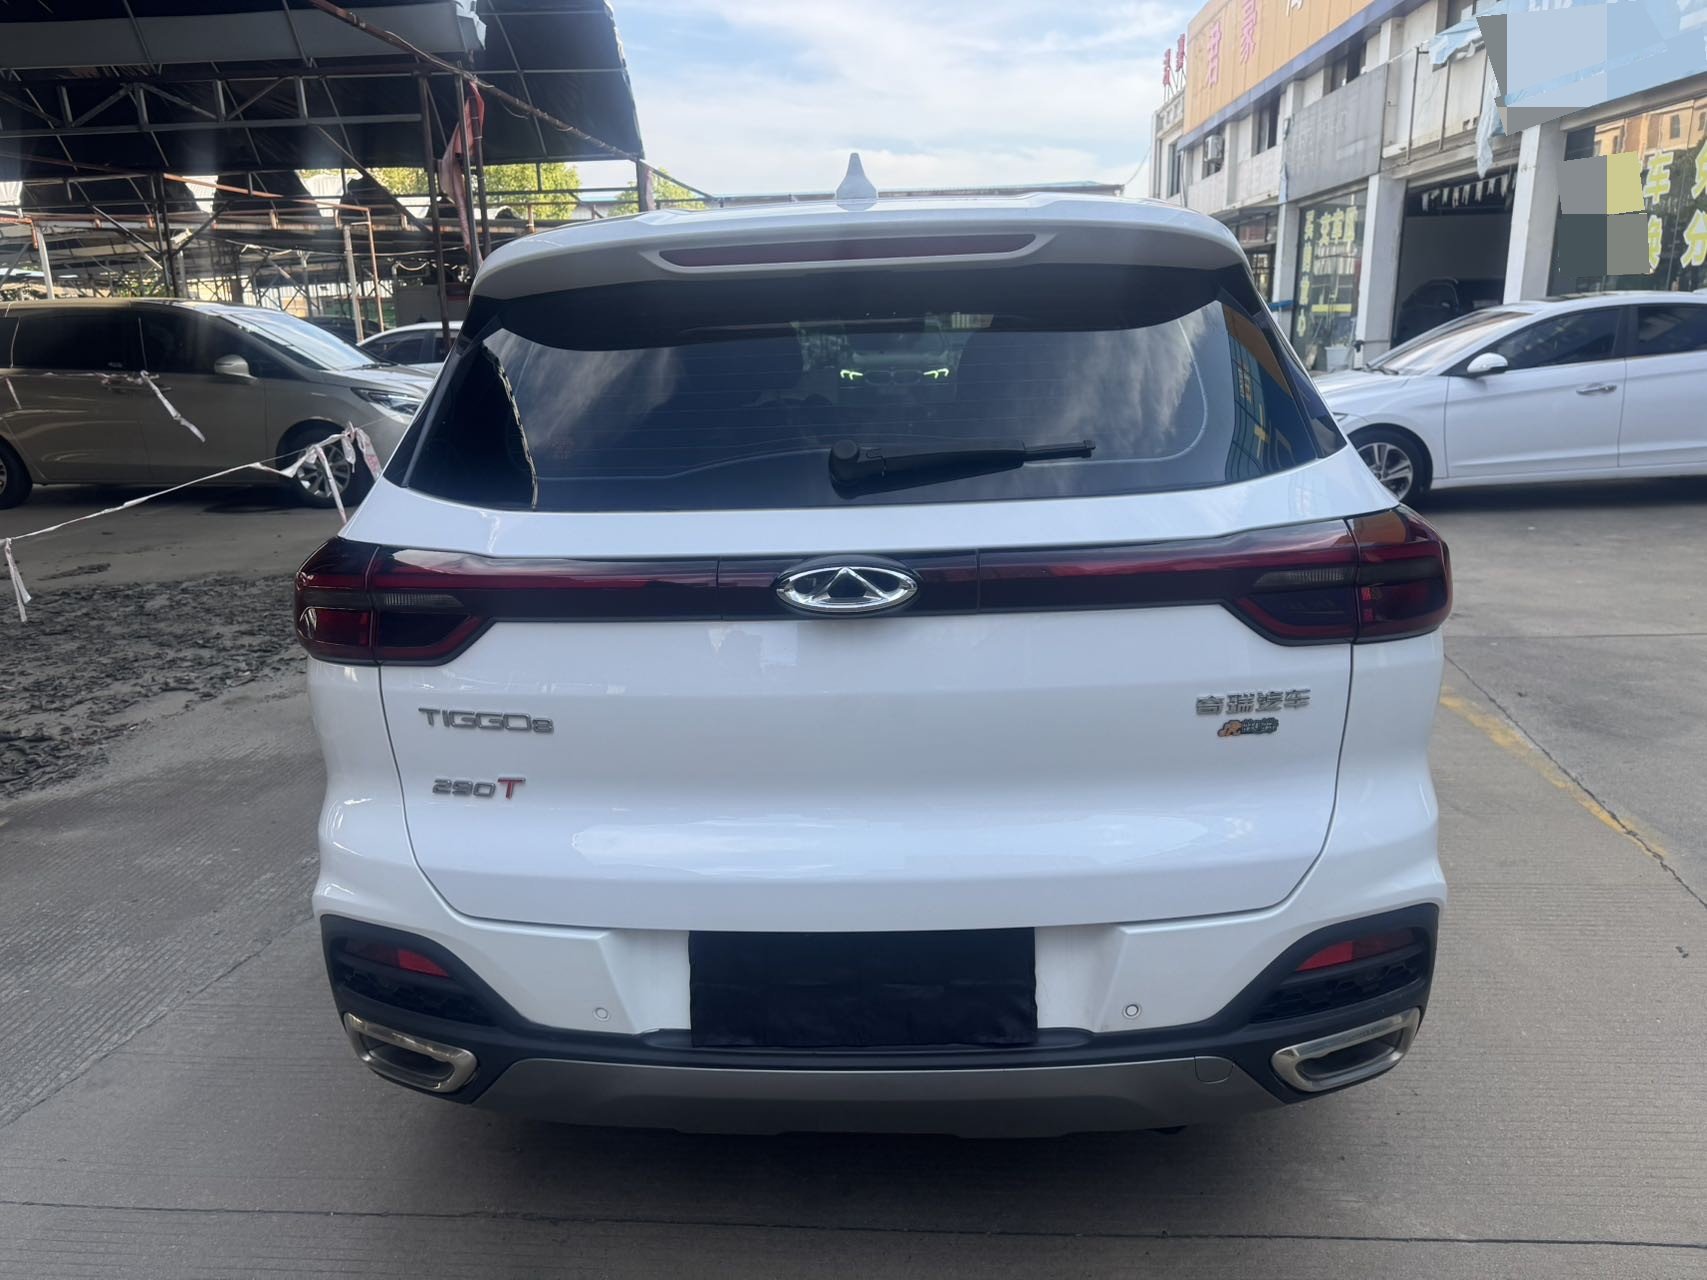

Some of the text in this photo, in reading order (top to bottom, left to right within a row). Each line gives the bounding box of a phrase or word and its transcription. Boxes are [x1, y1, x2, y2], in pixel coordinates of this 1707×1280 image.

[1196, 689, 1311, 715] 奇瑞汽车
[432, 777, 526, 800] 290T
